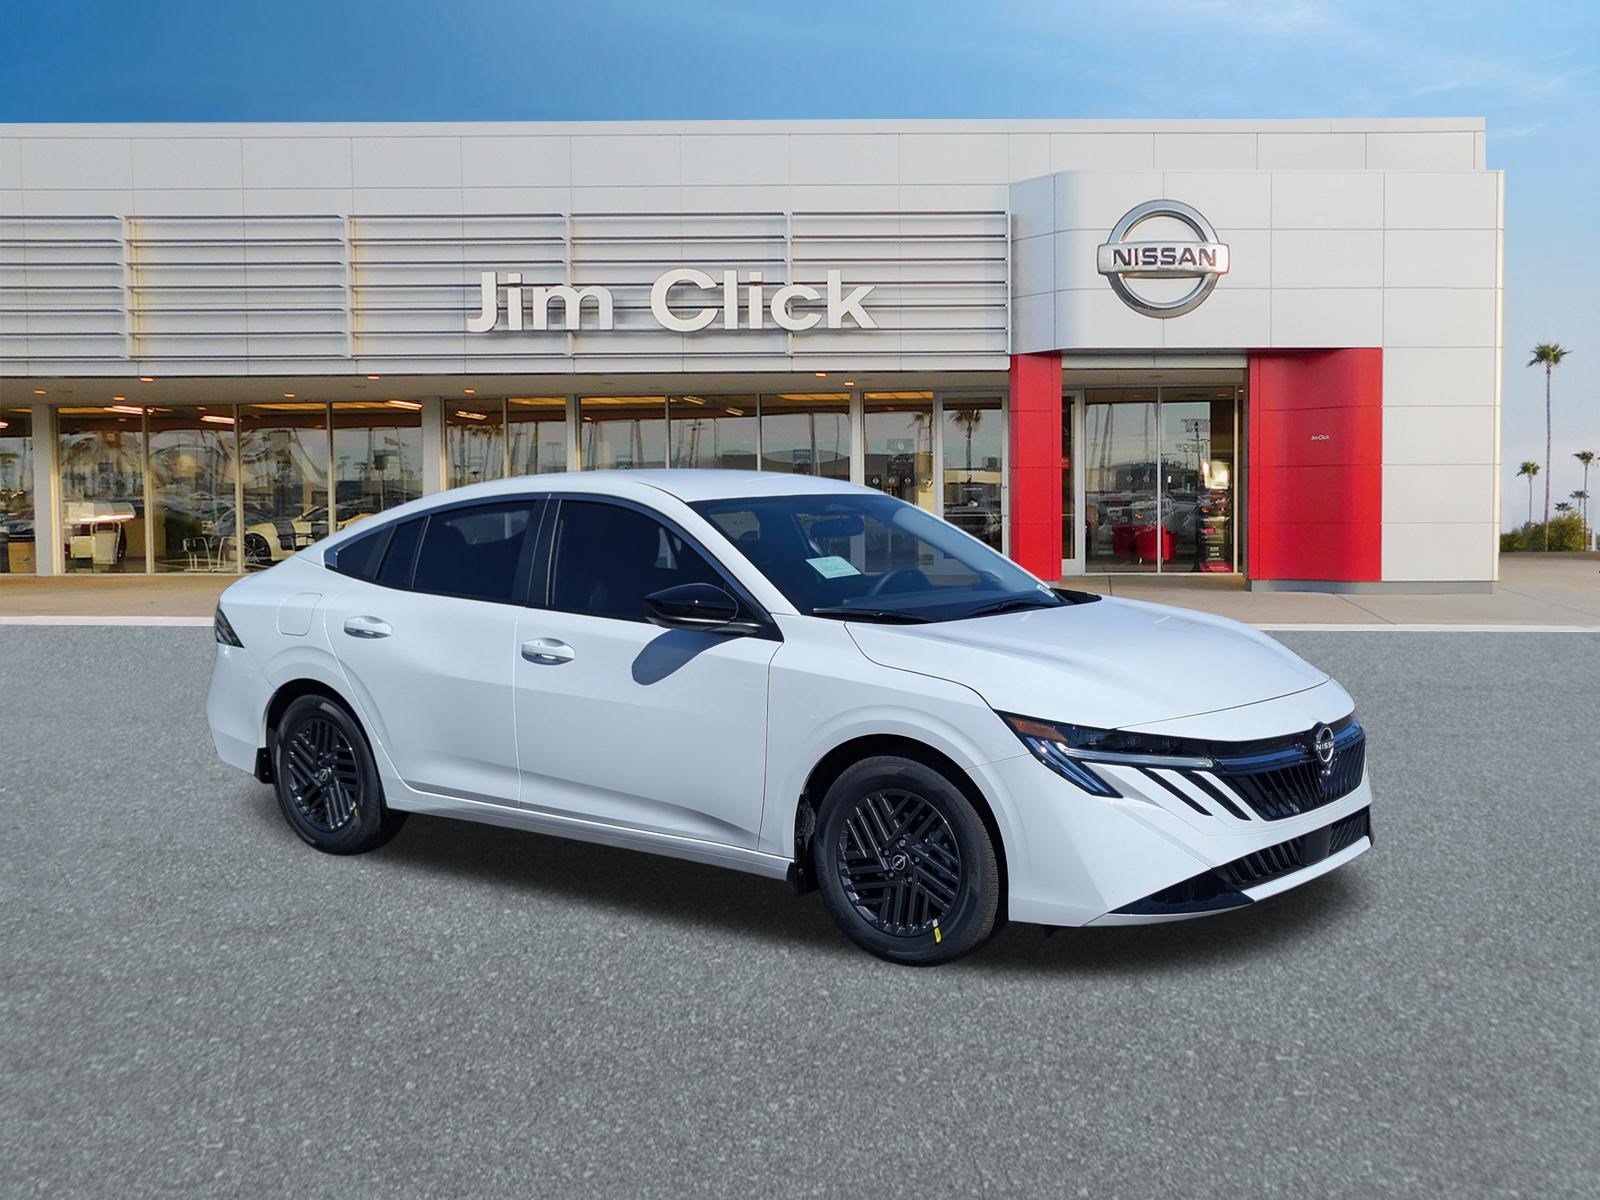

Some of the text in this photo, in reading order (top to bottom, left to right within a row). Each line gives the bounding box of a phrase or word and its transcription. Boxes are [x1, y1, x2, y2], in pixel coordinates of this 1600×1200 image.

[1112, 247, 1217, 267] NISSAN
[466, 268, 879, 333] Jim Click
